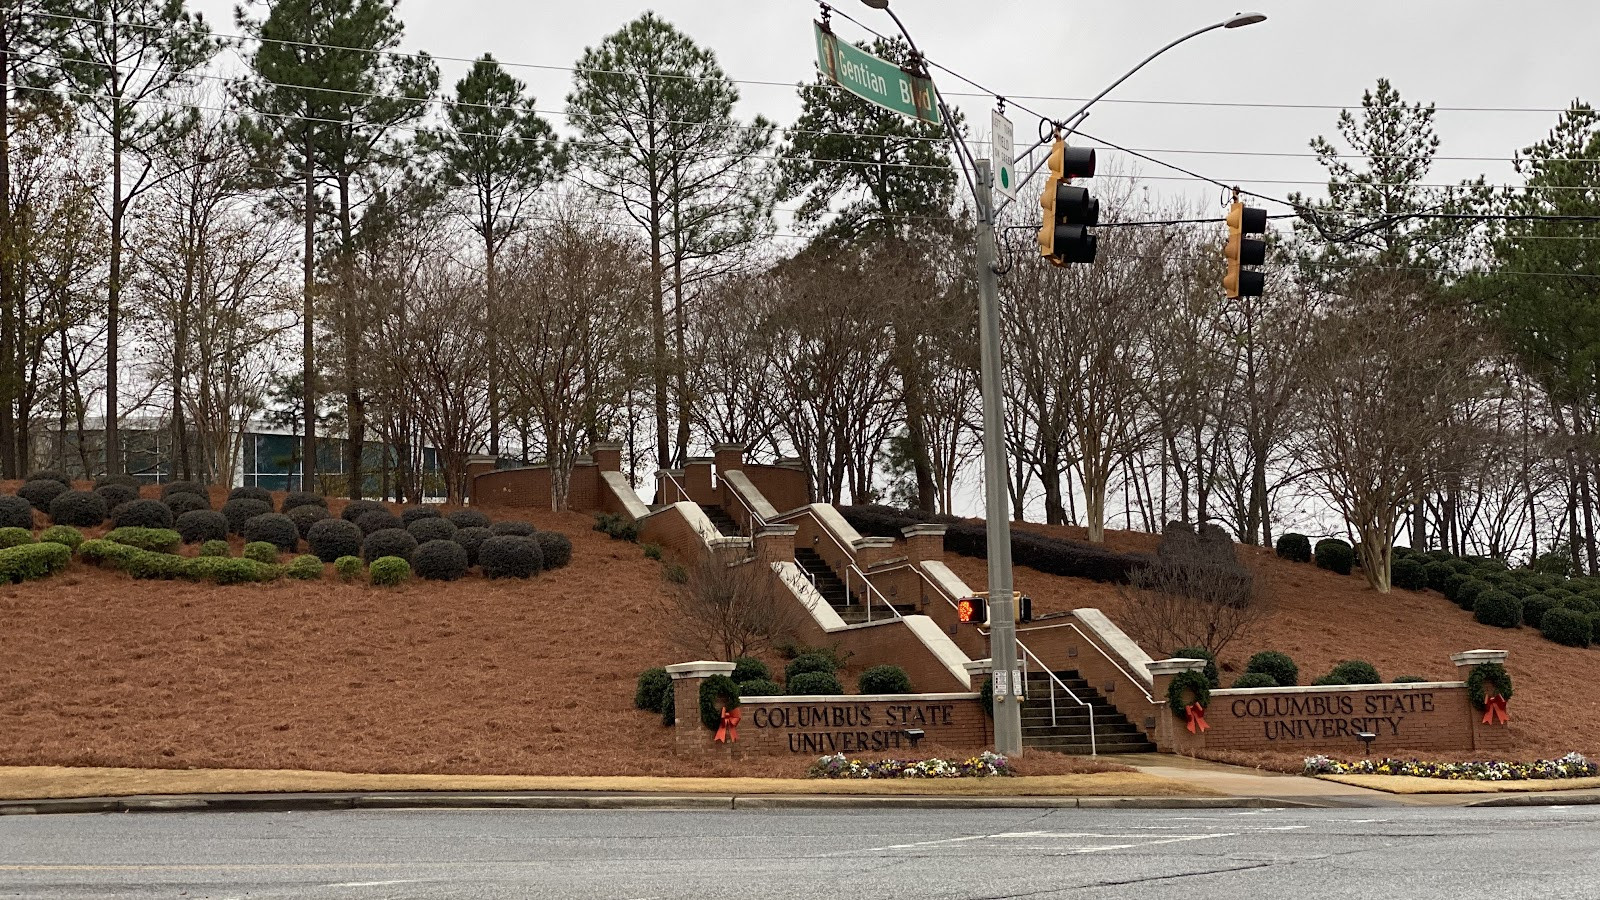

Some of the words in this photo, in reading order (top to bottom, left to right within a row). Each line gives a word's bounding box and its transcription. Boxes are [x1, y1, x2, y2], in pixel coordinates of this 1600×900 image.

[839, 49, 887, 96] Gentian
[898, 78, 932, 111] Blvd
[997, 133, 1009, 151] YIELD
[753, 705, 872, 728] COLUMBUS
[886, 704, 954, 726] STATE
[1231, 695, 1354, 718] COLUMBUS
[1365, 693, 1435, 714] STATE
[1263, 716, 1404, 740] UNIVERSITY
